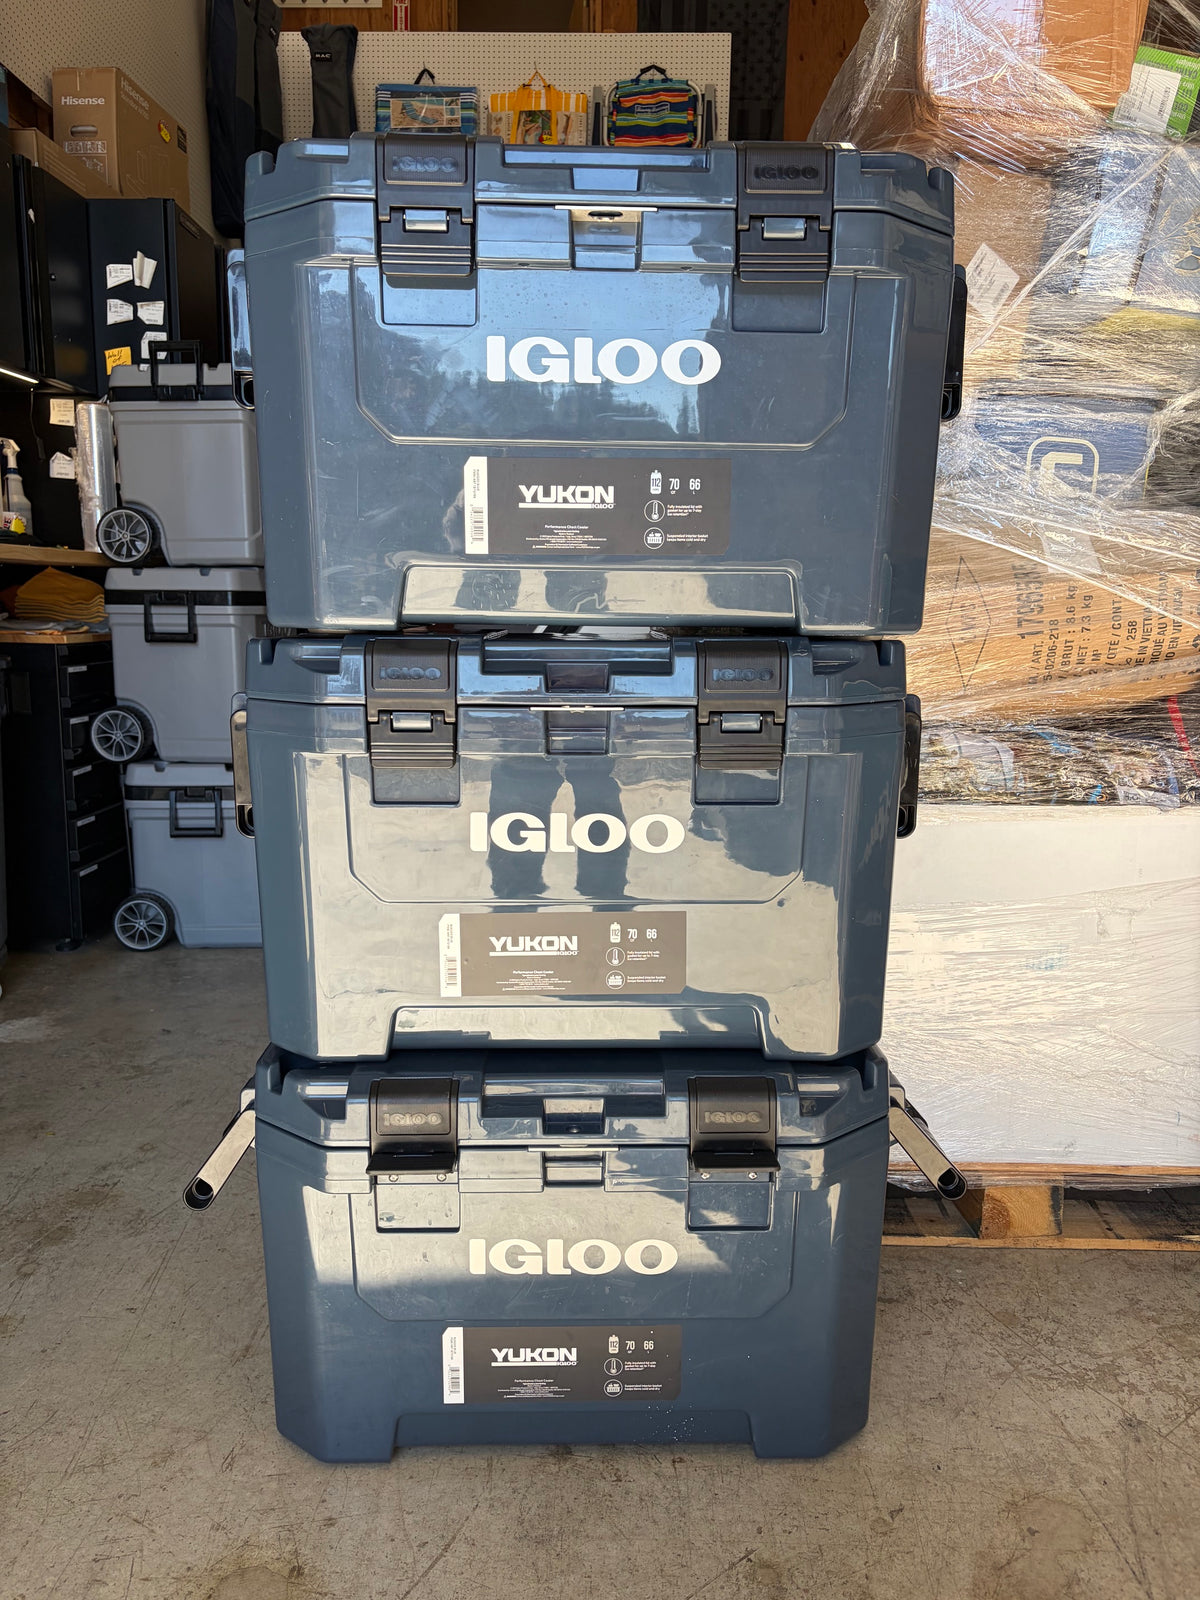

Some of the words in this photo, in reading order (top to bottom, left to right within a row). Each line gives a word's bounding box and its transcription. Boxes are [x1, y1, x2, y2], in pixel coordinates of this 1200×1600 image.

[61, 96, 105, 105] Hisense
[754, 164, 818, 180] IGLOO
[486, 336, 722, 386] IGLOO
[652, 478, 660, 488] 112
[668, 478, 680, 490] 70
[690, 478, 700, 490] 66
[518, 486, 614, 504] YUKON
[1065, 585, 1078, 600] kg
[1081, 594, 1093, 609] kg
[1064, 606, 1075, 624] 8.6
[1081, 615, 1092, 633] 7.3
[1126, 620, 1137, 641] 258
[1156, 622, 1168, 636] AU
[1137, 645, 1148, 655] IN
[1168, 636, 1180, 649] EN
[1032, 640, 1044, 664] ART.
[1061, 639, 1075, 666] BRUT
[1076, 645, 1088, 665] NET
[469, 812, 686, 854] IGLOO
[627, 929, 638, 939] 70
[646, 929, 657, 939] 66
[489, 936, 578, 951] YUKON
[383, 1113, 442, 1126] IGLOO
[704, 1111, 763, 1124] IGLOO
[469, 1239, 678, 1275] IGLOO
[626, 1341, 635, 1350] 70
[644, 1341, 654, 1350] 66
[491, 1348, 577, 1362] YUKON
